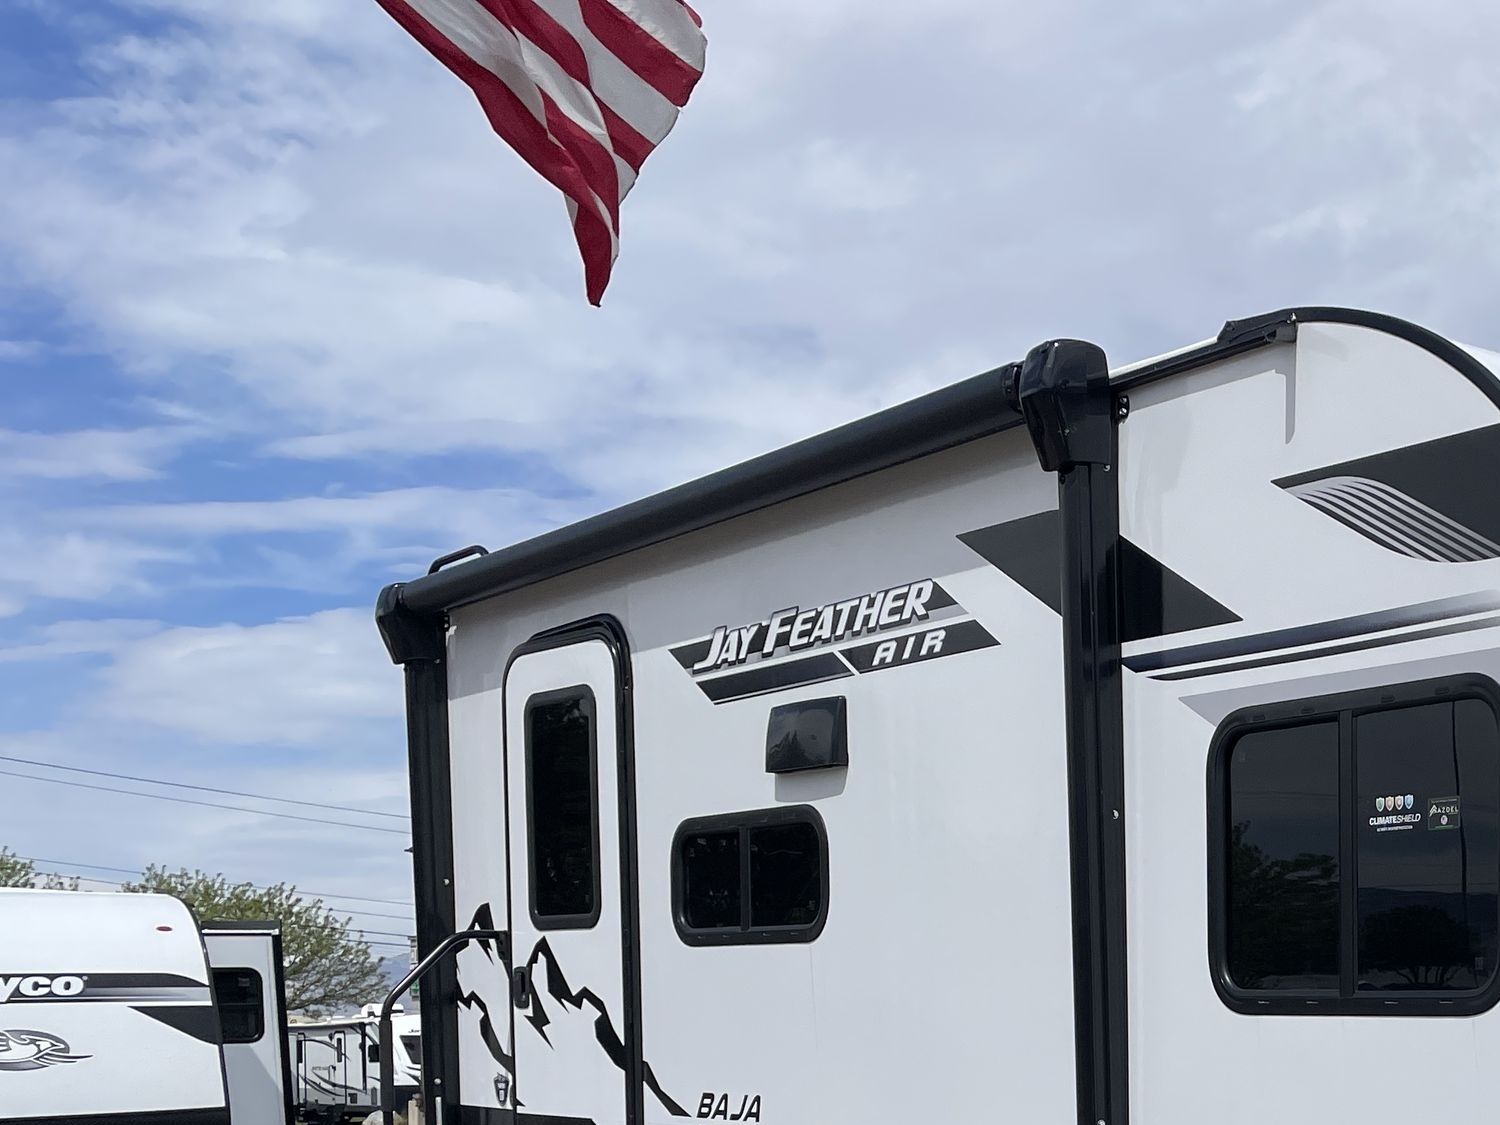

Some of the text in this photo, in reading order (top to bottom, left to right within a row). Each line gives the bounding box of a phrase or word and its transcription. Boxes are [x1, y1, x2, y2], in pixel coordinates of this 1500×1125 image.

[692, 577, 936, 674] JAY FEATHER
[872, 628, 947, 667] AIR
[696, 1092, 761, 1122] BAJA
